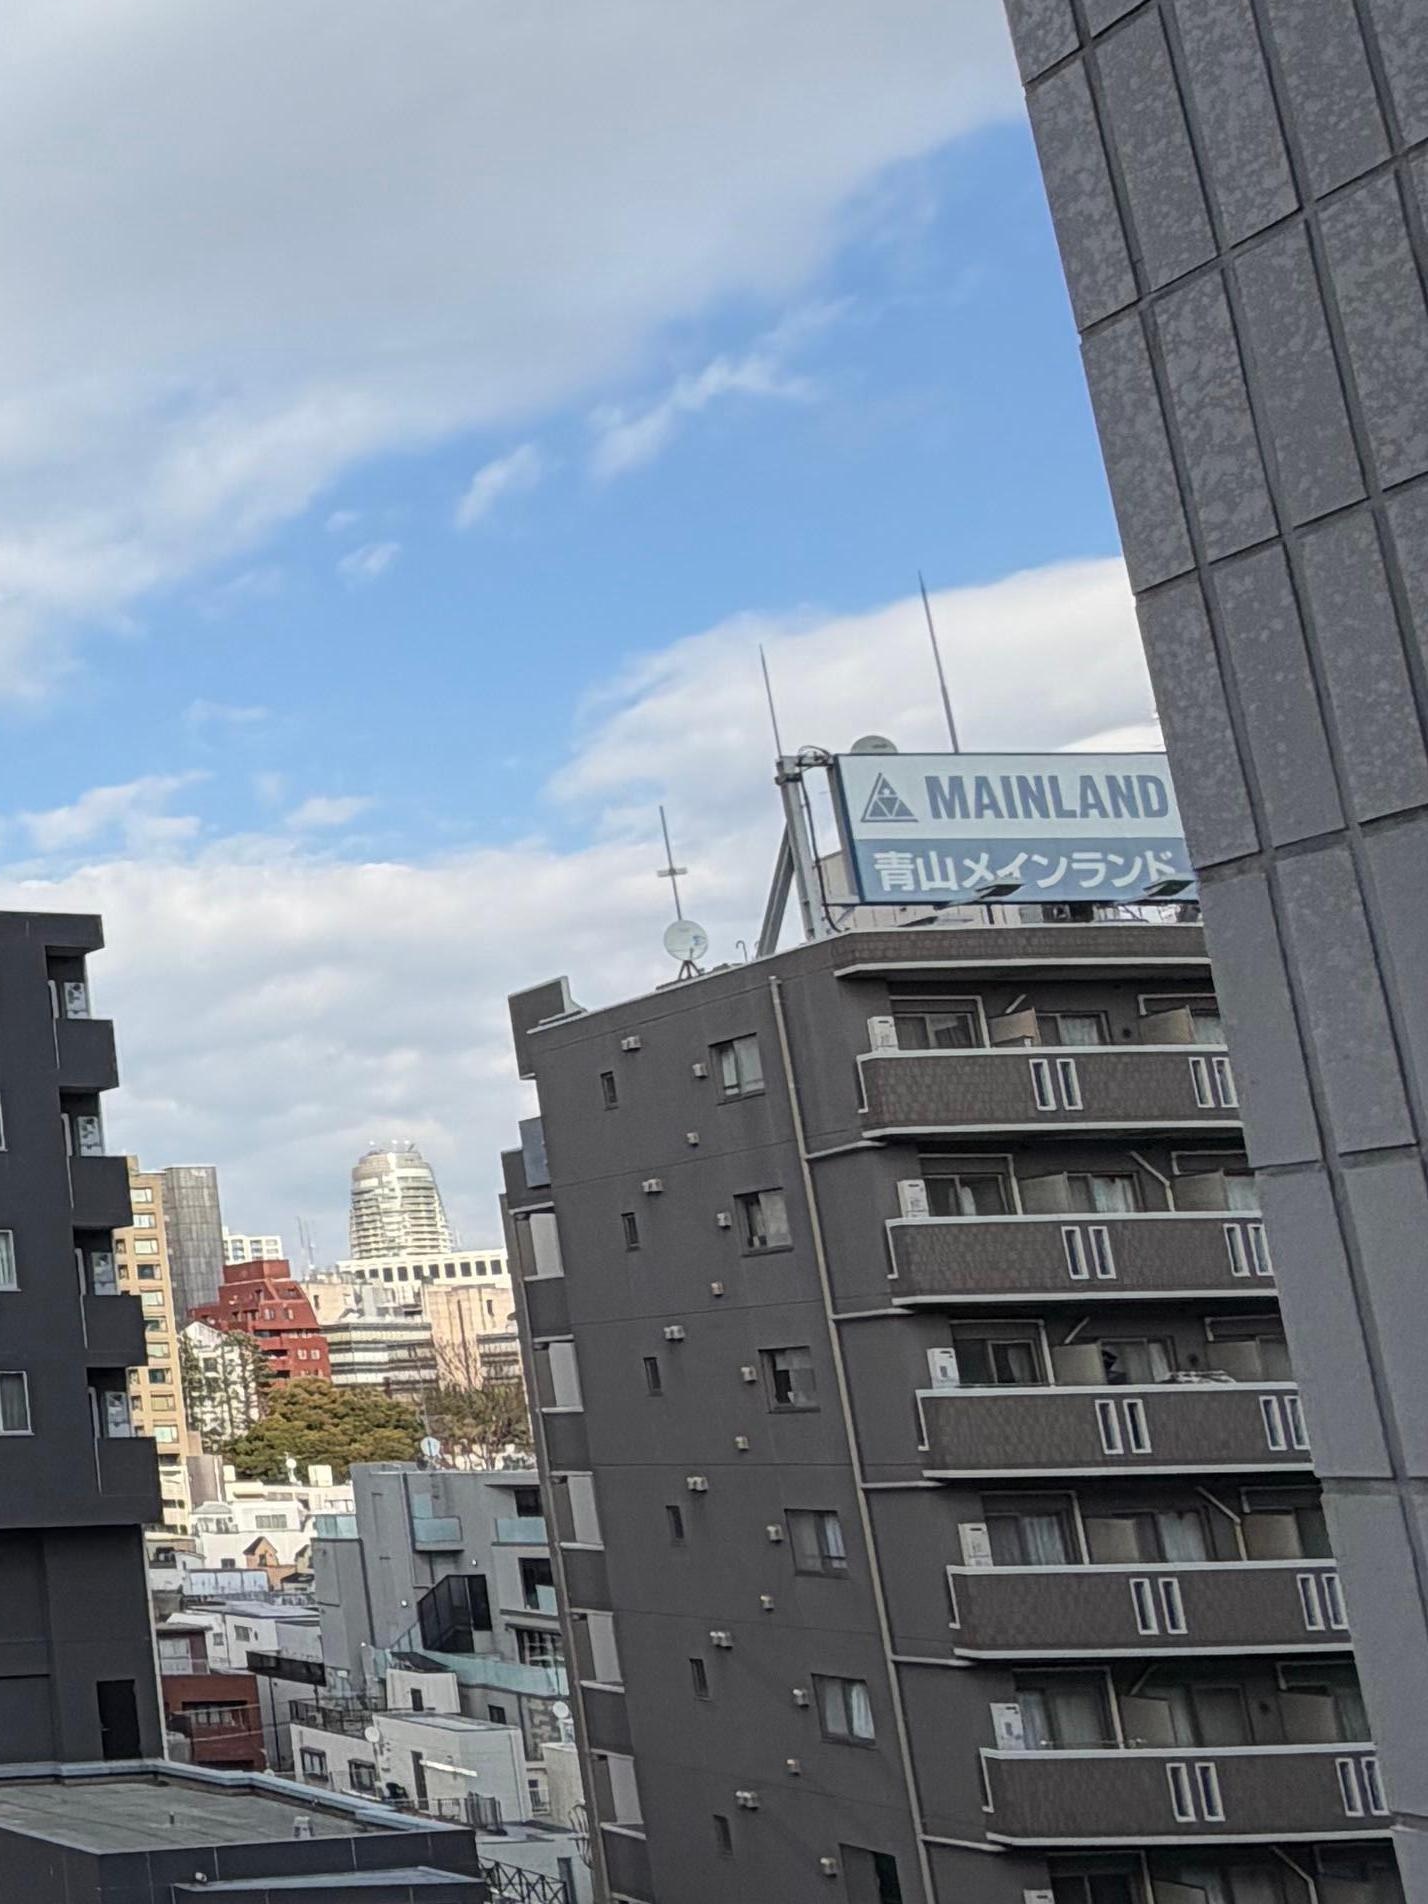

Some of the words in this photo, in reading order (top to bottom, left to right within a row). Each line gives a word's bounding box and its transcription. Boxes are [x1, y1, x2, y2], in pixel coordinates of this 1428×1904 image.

[923, 775, 1169, 820] MAINLAND
[873, 850, 1176, 892] 青山メインランド
